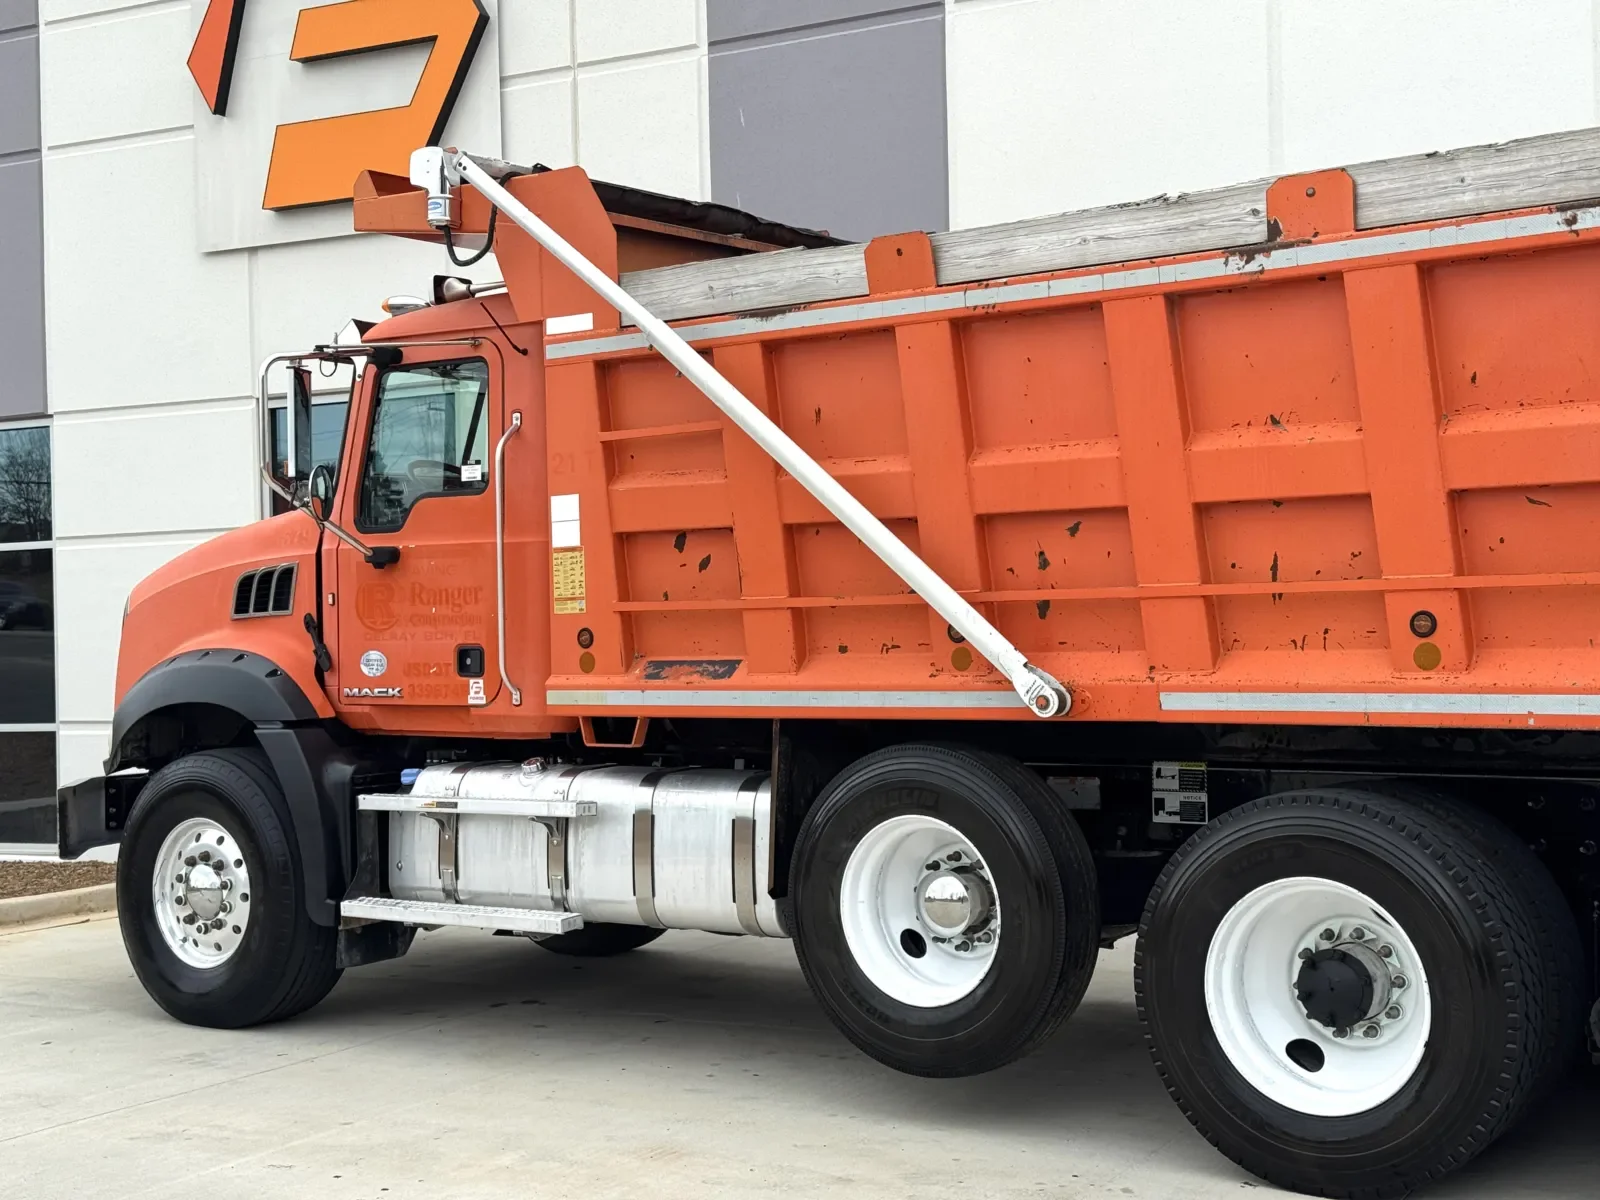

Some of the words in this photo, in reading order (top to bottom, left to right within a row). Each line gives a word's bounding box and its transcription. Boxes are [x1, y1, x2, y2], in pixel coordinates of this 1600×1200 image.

[410, 582, 483, 612] Ranger
[403, 662, 452, 678] USDOT
[344, 687, 403, 698] MACK
